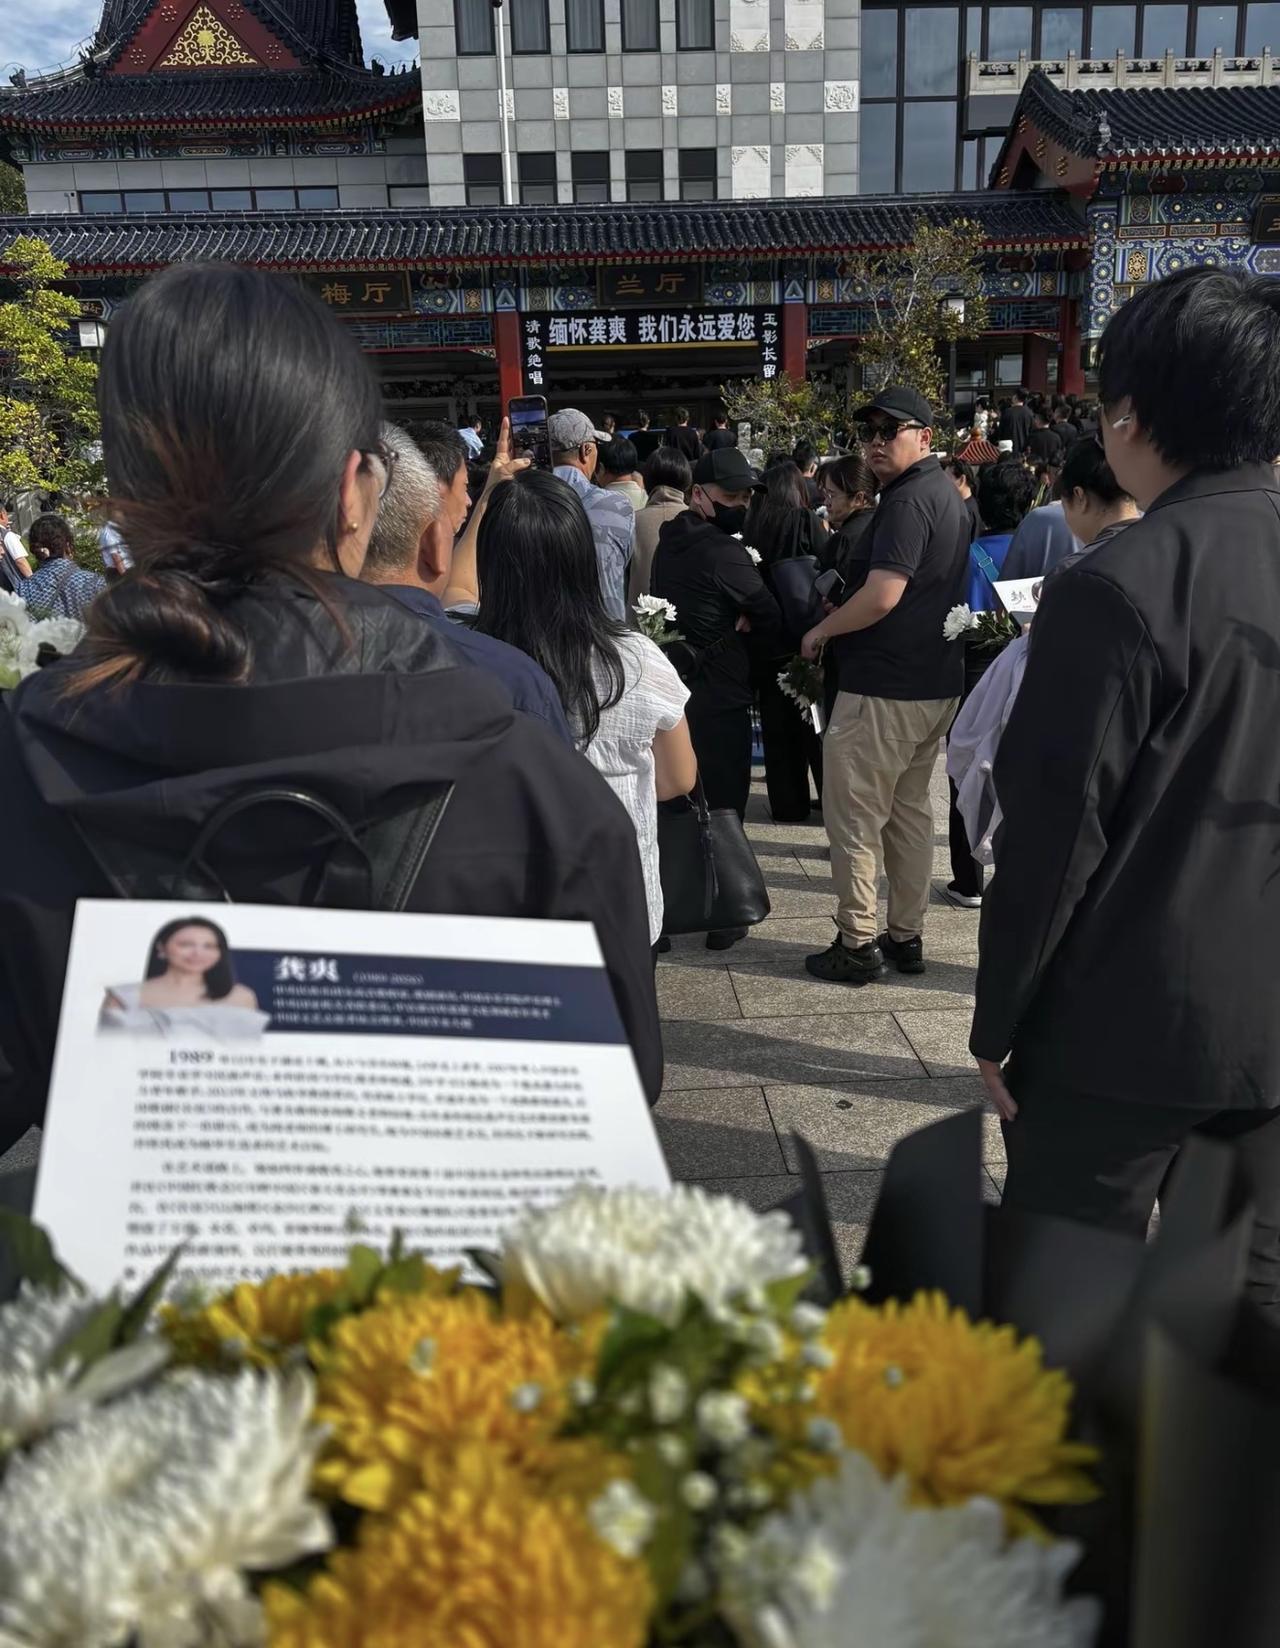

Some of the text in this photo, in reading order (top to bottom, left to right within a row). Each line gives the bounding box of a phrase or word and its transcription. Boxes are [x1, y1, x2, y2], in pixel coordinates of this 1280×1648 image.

[321, 283, 391, 305] 梅厅
[615, 273, 686, 295] 兰厅
[548, 313, 756, 345] 缅怀龚爽 我们永远爱您
[525, 320, 543, 385] 清歌绝唱
[762, 313, 778, 378] 玉影长留
